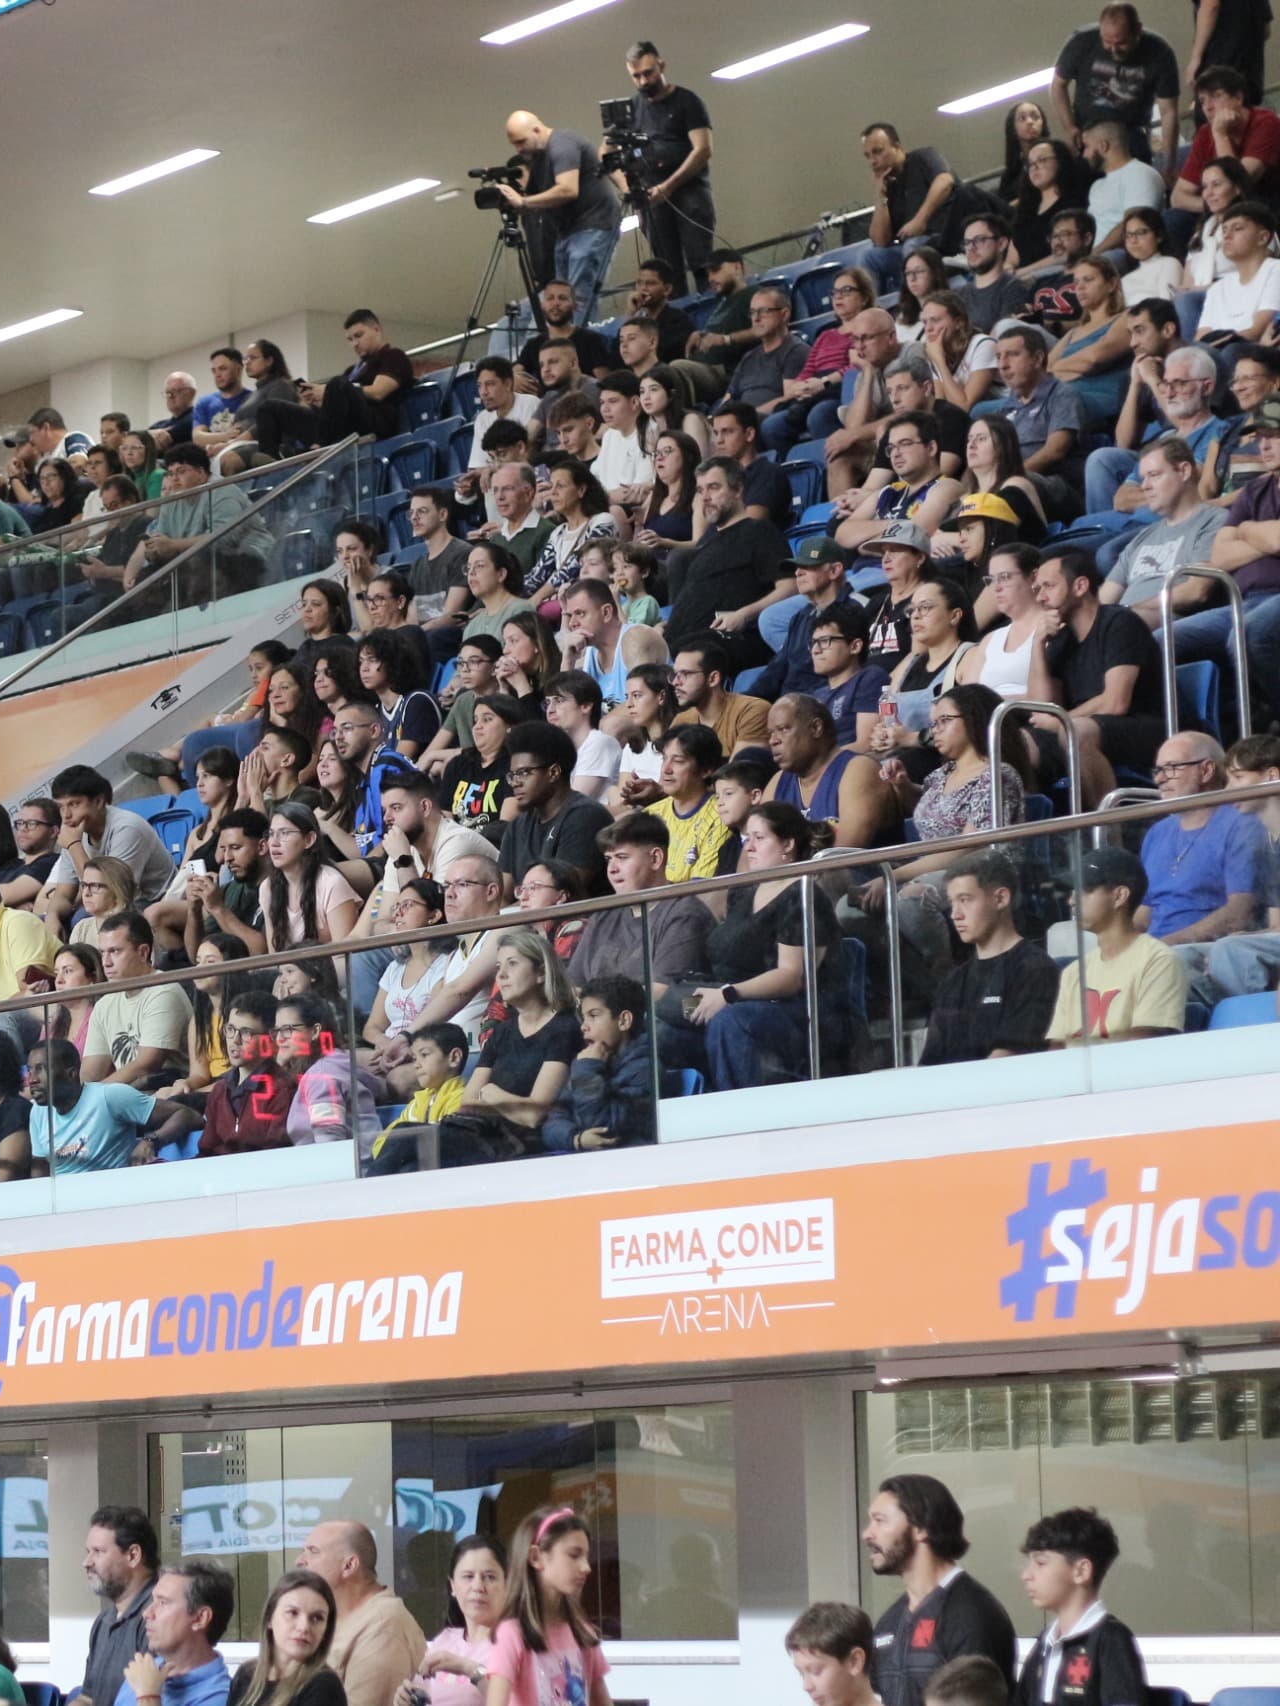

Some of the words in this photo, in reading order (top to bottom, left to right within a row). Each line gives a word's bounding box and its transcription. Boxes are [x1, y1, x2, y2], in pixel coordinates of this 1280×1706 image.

[610, 1230, 706, 1268] FARMA
[718, 1216, 824, 1259] CONDE
[660, 1290, 770, 1335] ARENA
